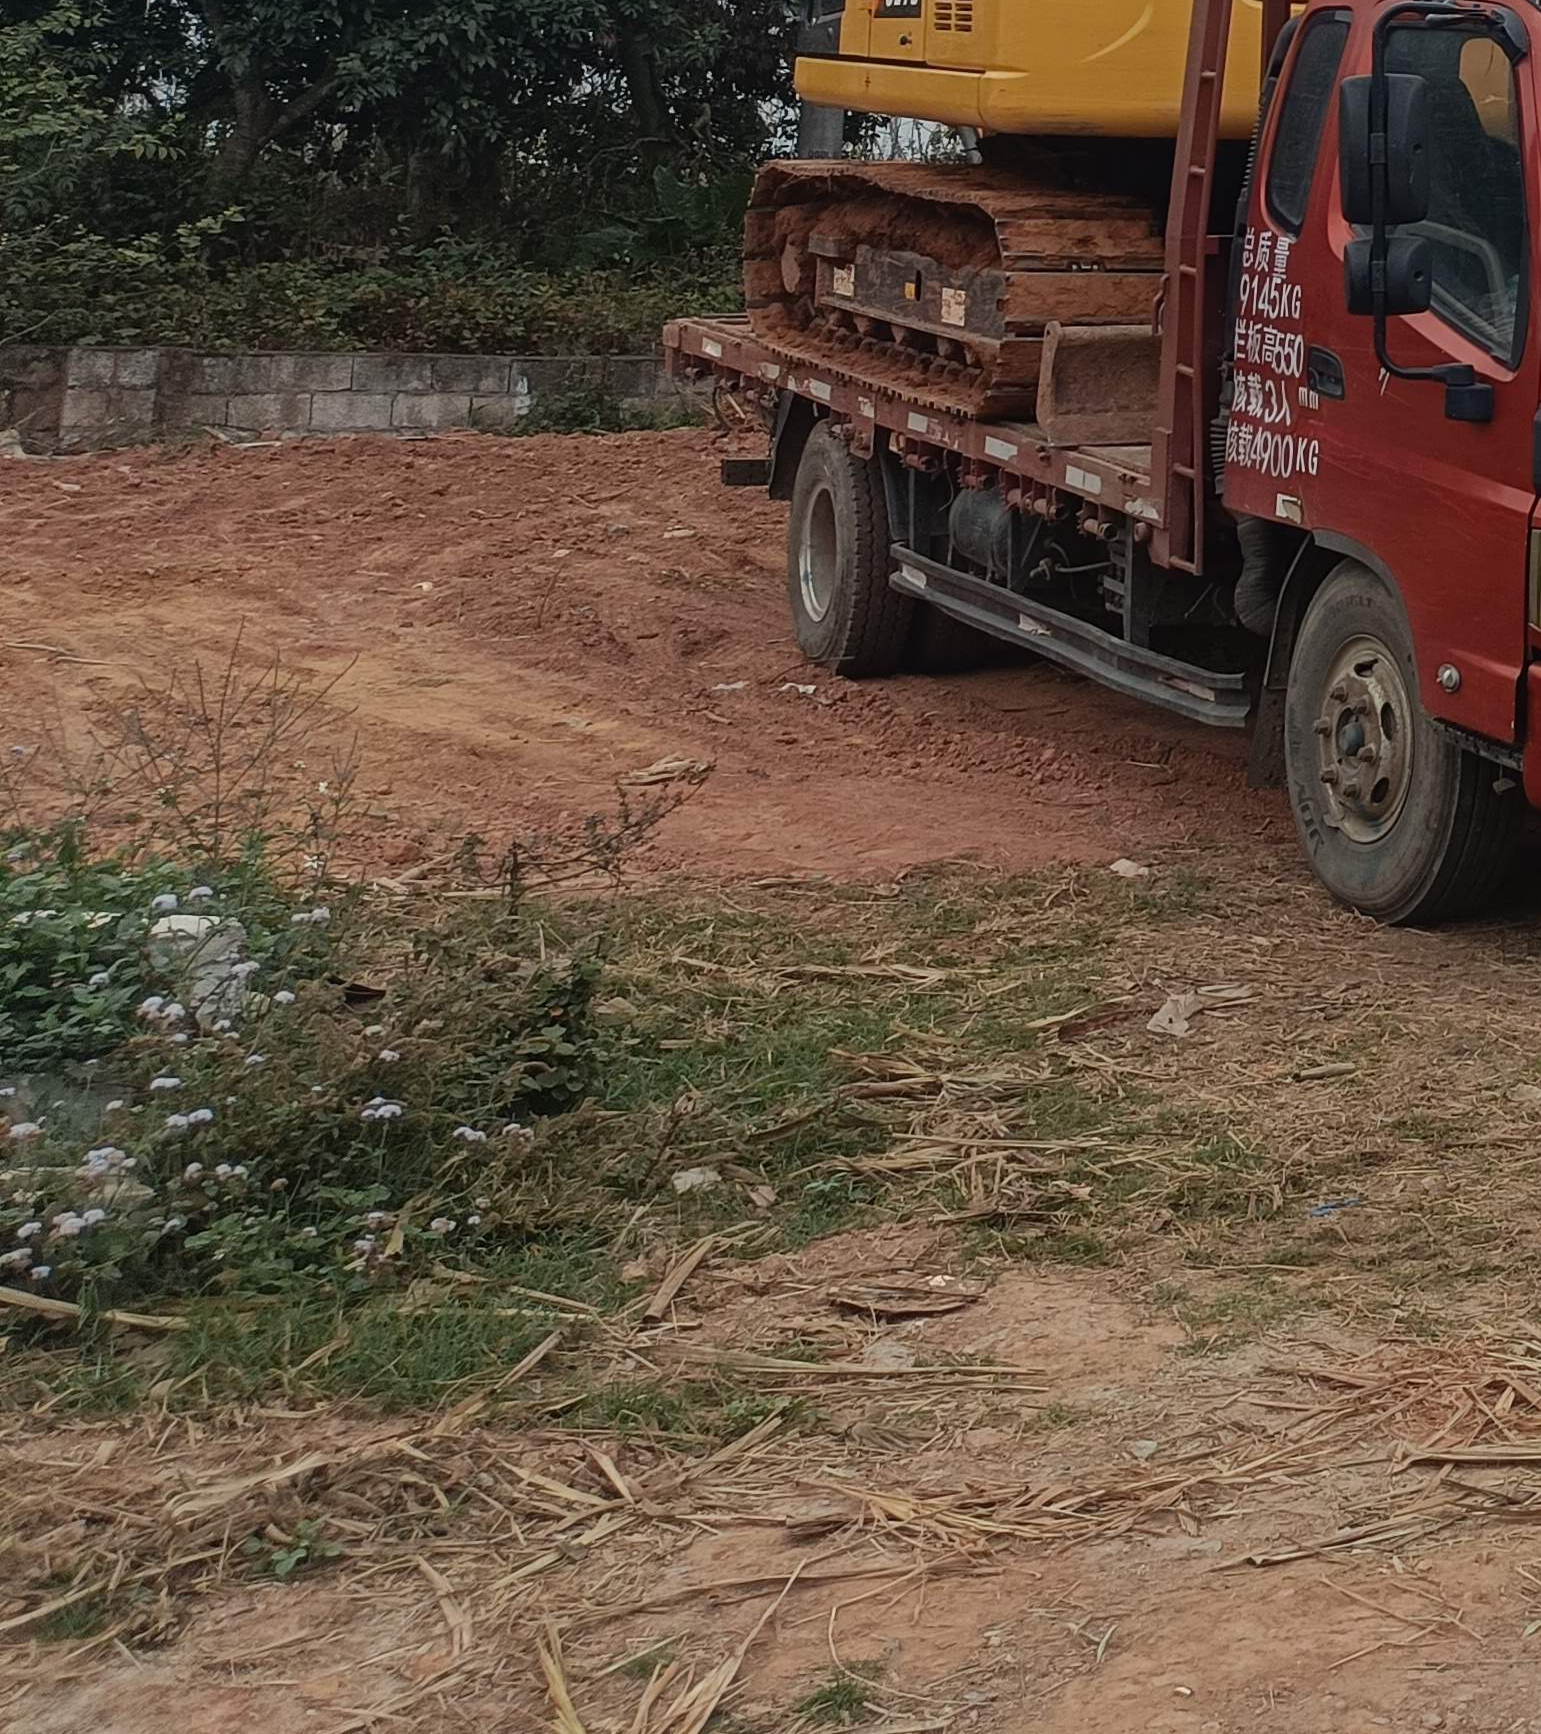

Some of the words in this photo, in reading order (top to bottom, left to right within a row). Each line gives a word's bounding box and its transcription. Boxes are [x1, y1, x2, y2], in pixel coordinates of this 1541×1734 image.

[1242, 226, 1297, 280] 总质量
[1240, 273, 1302, 320] 9145KG
